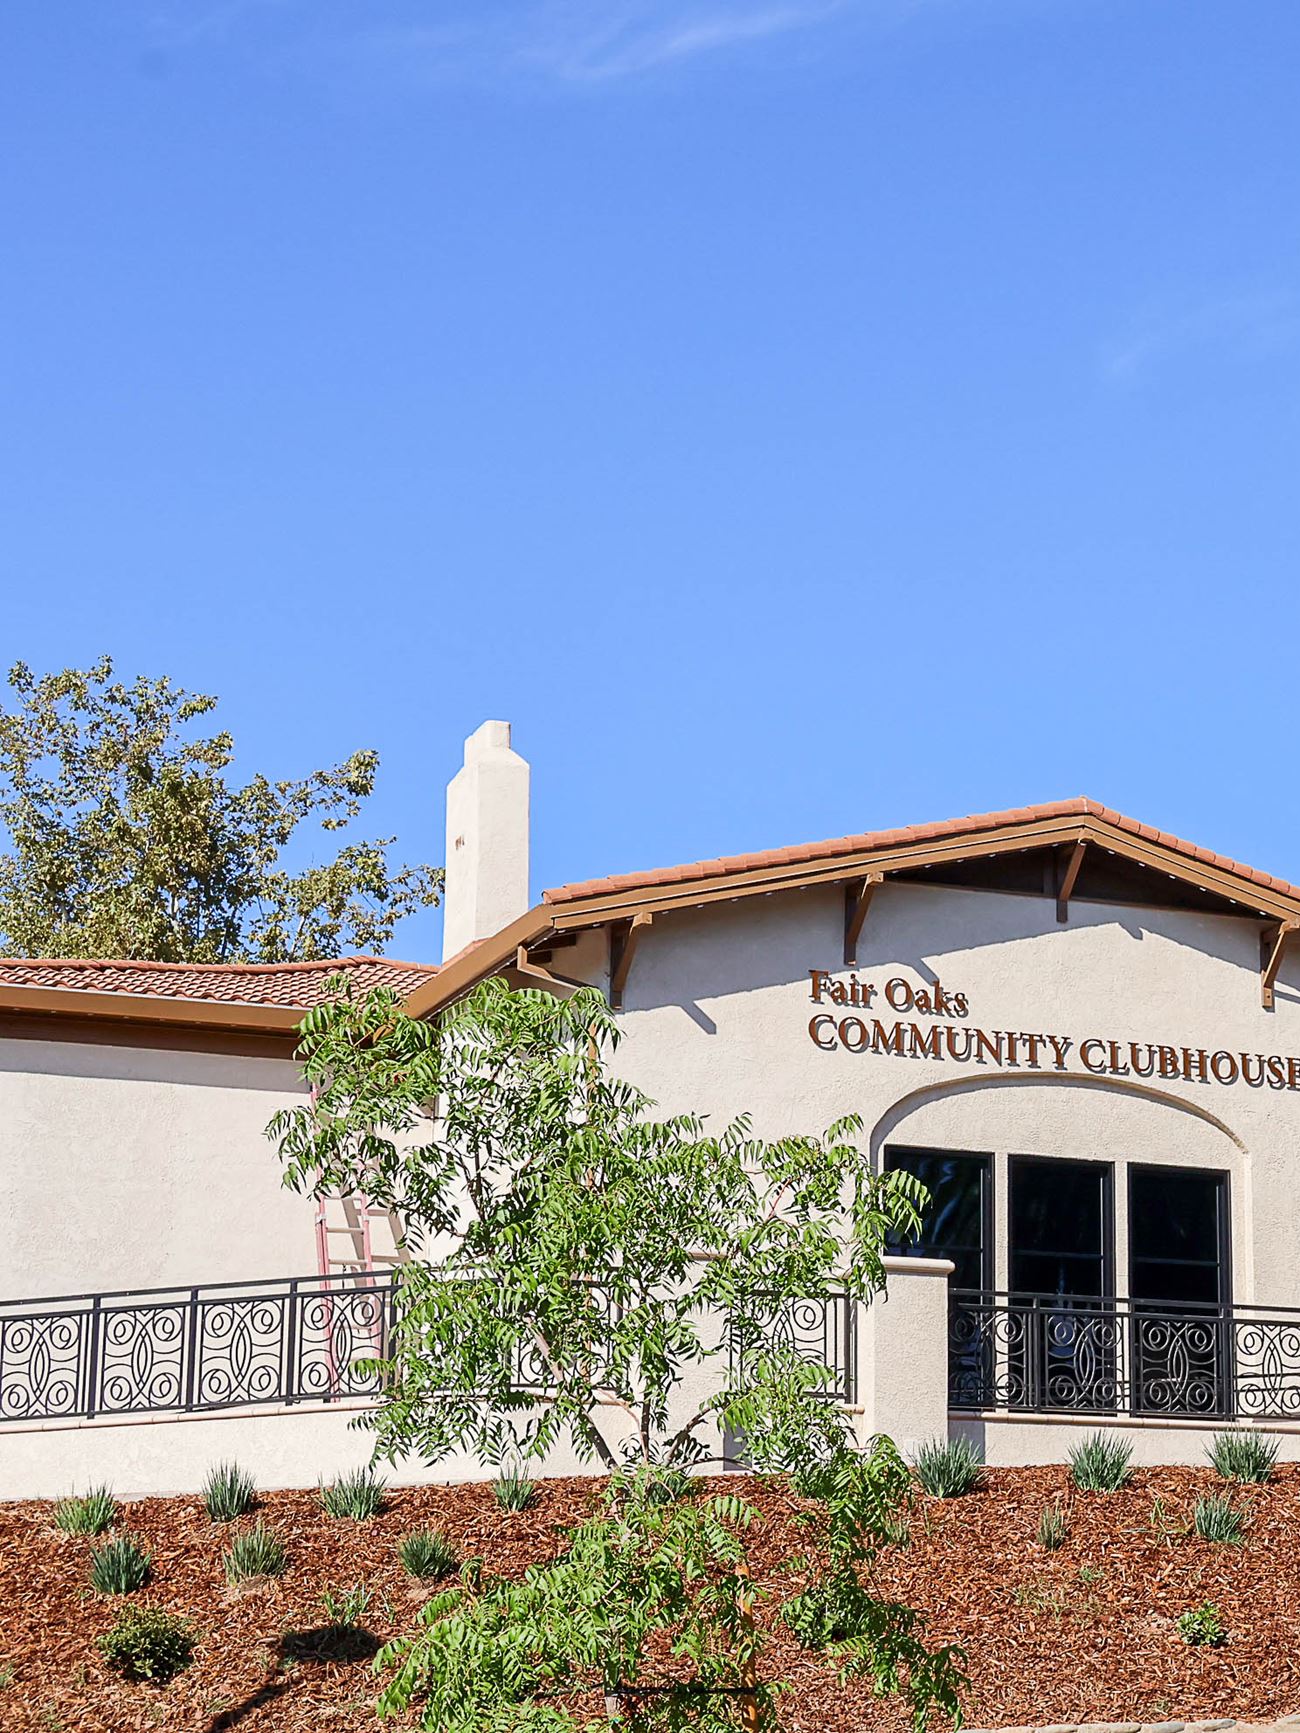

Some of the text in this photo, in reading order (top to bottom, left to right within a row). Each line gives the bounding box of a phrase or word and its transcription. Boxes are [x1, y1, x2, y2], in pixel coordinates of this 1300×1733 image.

[808, 970, 967, 1017] Fair Oaks
[808, 1014, 1072, 1069] COMMUNITY
